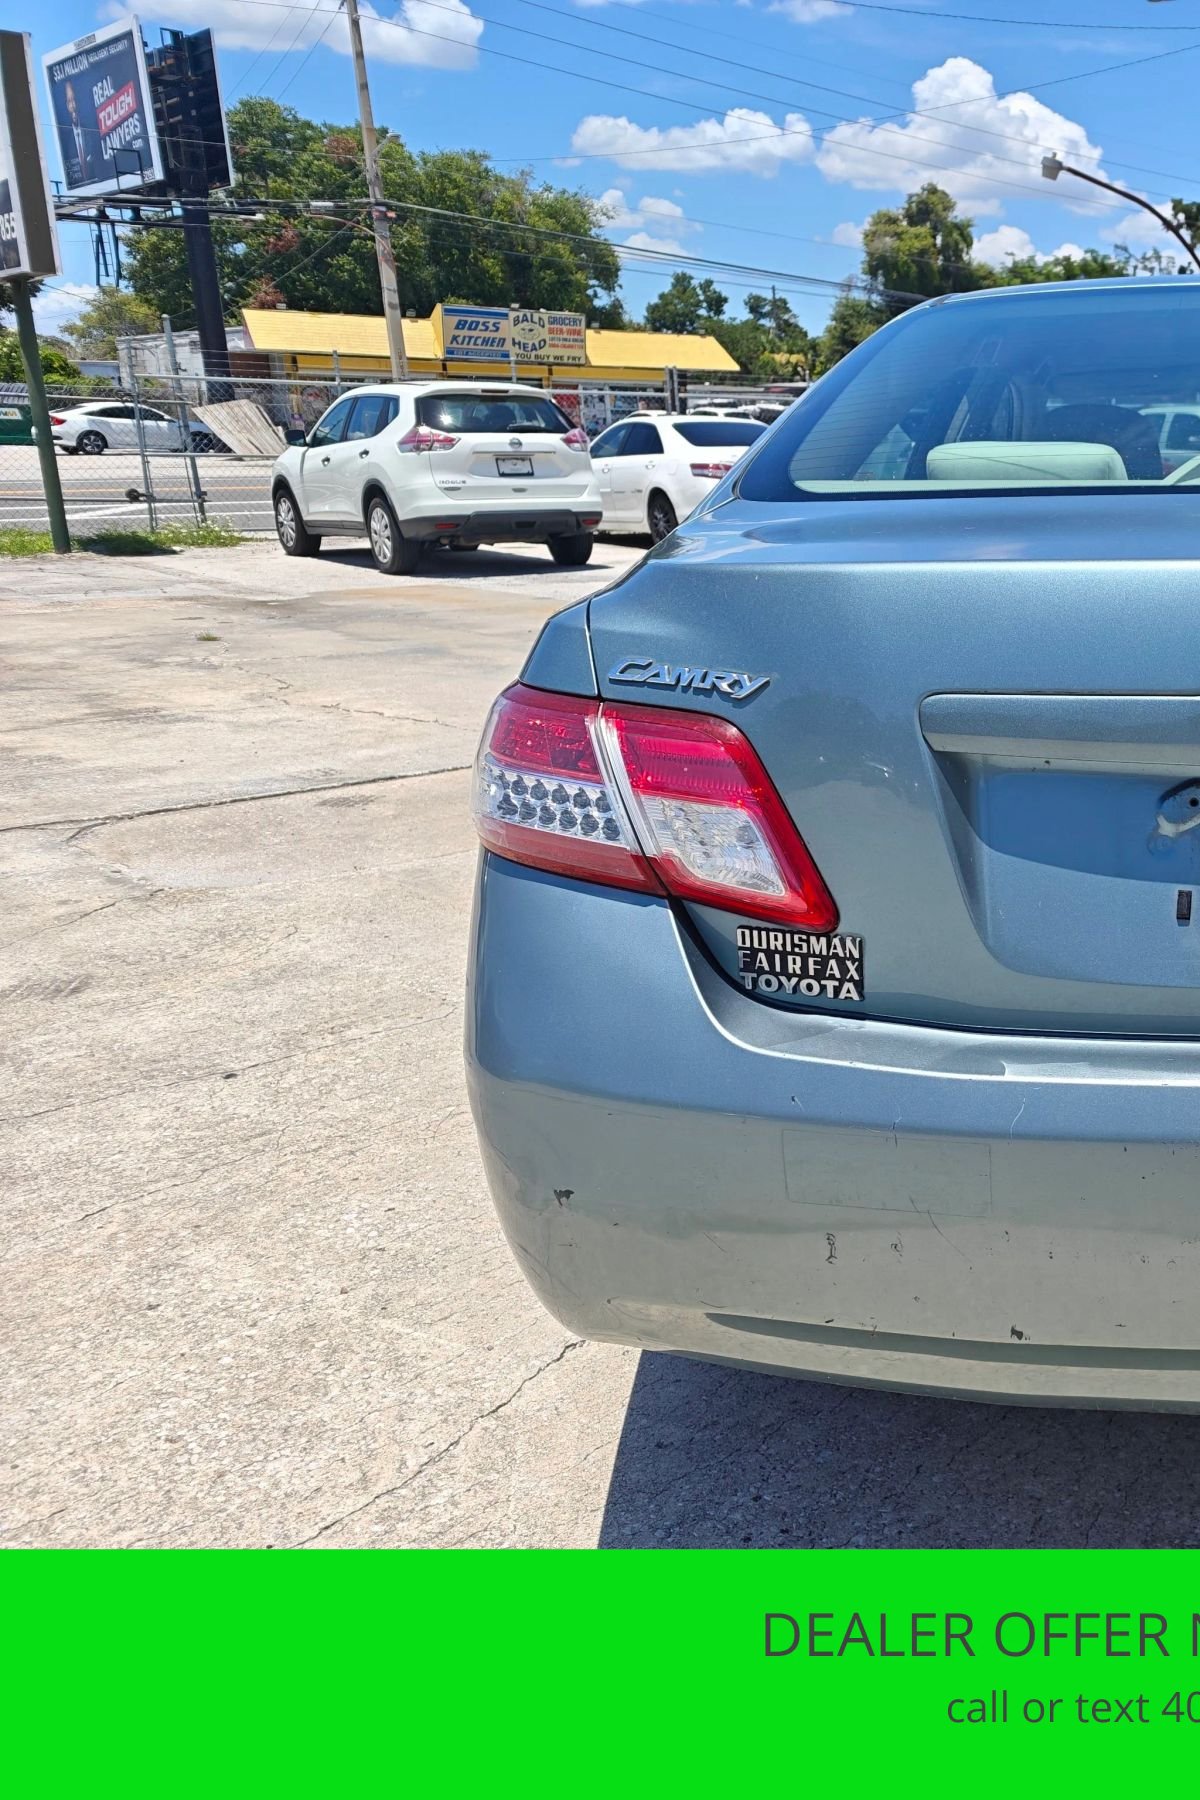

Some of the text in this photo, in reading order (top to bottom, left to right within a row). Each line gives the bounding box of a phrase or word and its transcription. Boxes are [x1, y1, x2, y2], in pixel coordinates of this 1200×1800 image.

[64, 53, 89, 77] MILLION
[87, 47, 109, 62] NEGLIGENT
[109, 39, 128, 55] SECURITY
[92, 75, 115, 107] REAL
[99, 87, 133, 130] TOUGH
[101, 112, 141, 160] LAWYERS
[454, 319, 501, 333] BOSS
[512, 313, 546, 329] BALD
[547, 315, 583, 327] GROCERY
[450, 334, 507, 348] KITCHEN
[511, 337, 547, 353] HEAD
[515, 352, 532, 360] YOU
[534, 353, 551, 361] BUY
[608, 658, 771, 700] CAMRY
[736, 927, 861, 958] OURISMAN
[738, 949, 860, 980] FAIRFAX
[740, 971, 861, 1001] TOYOTA
